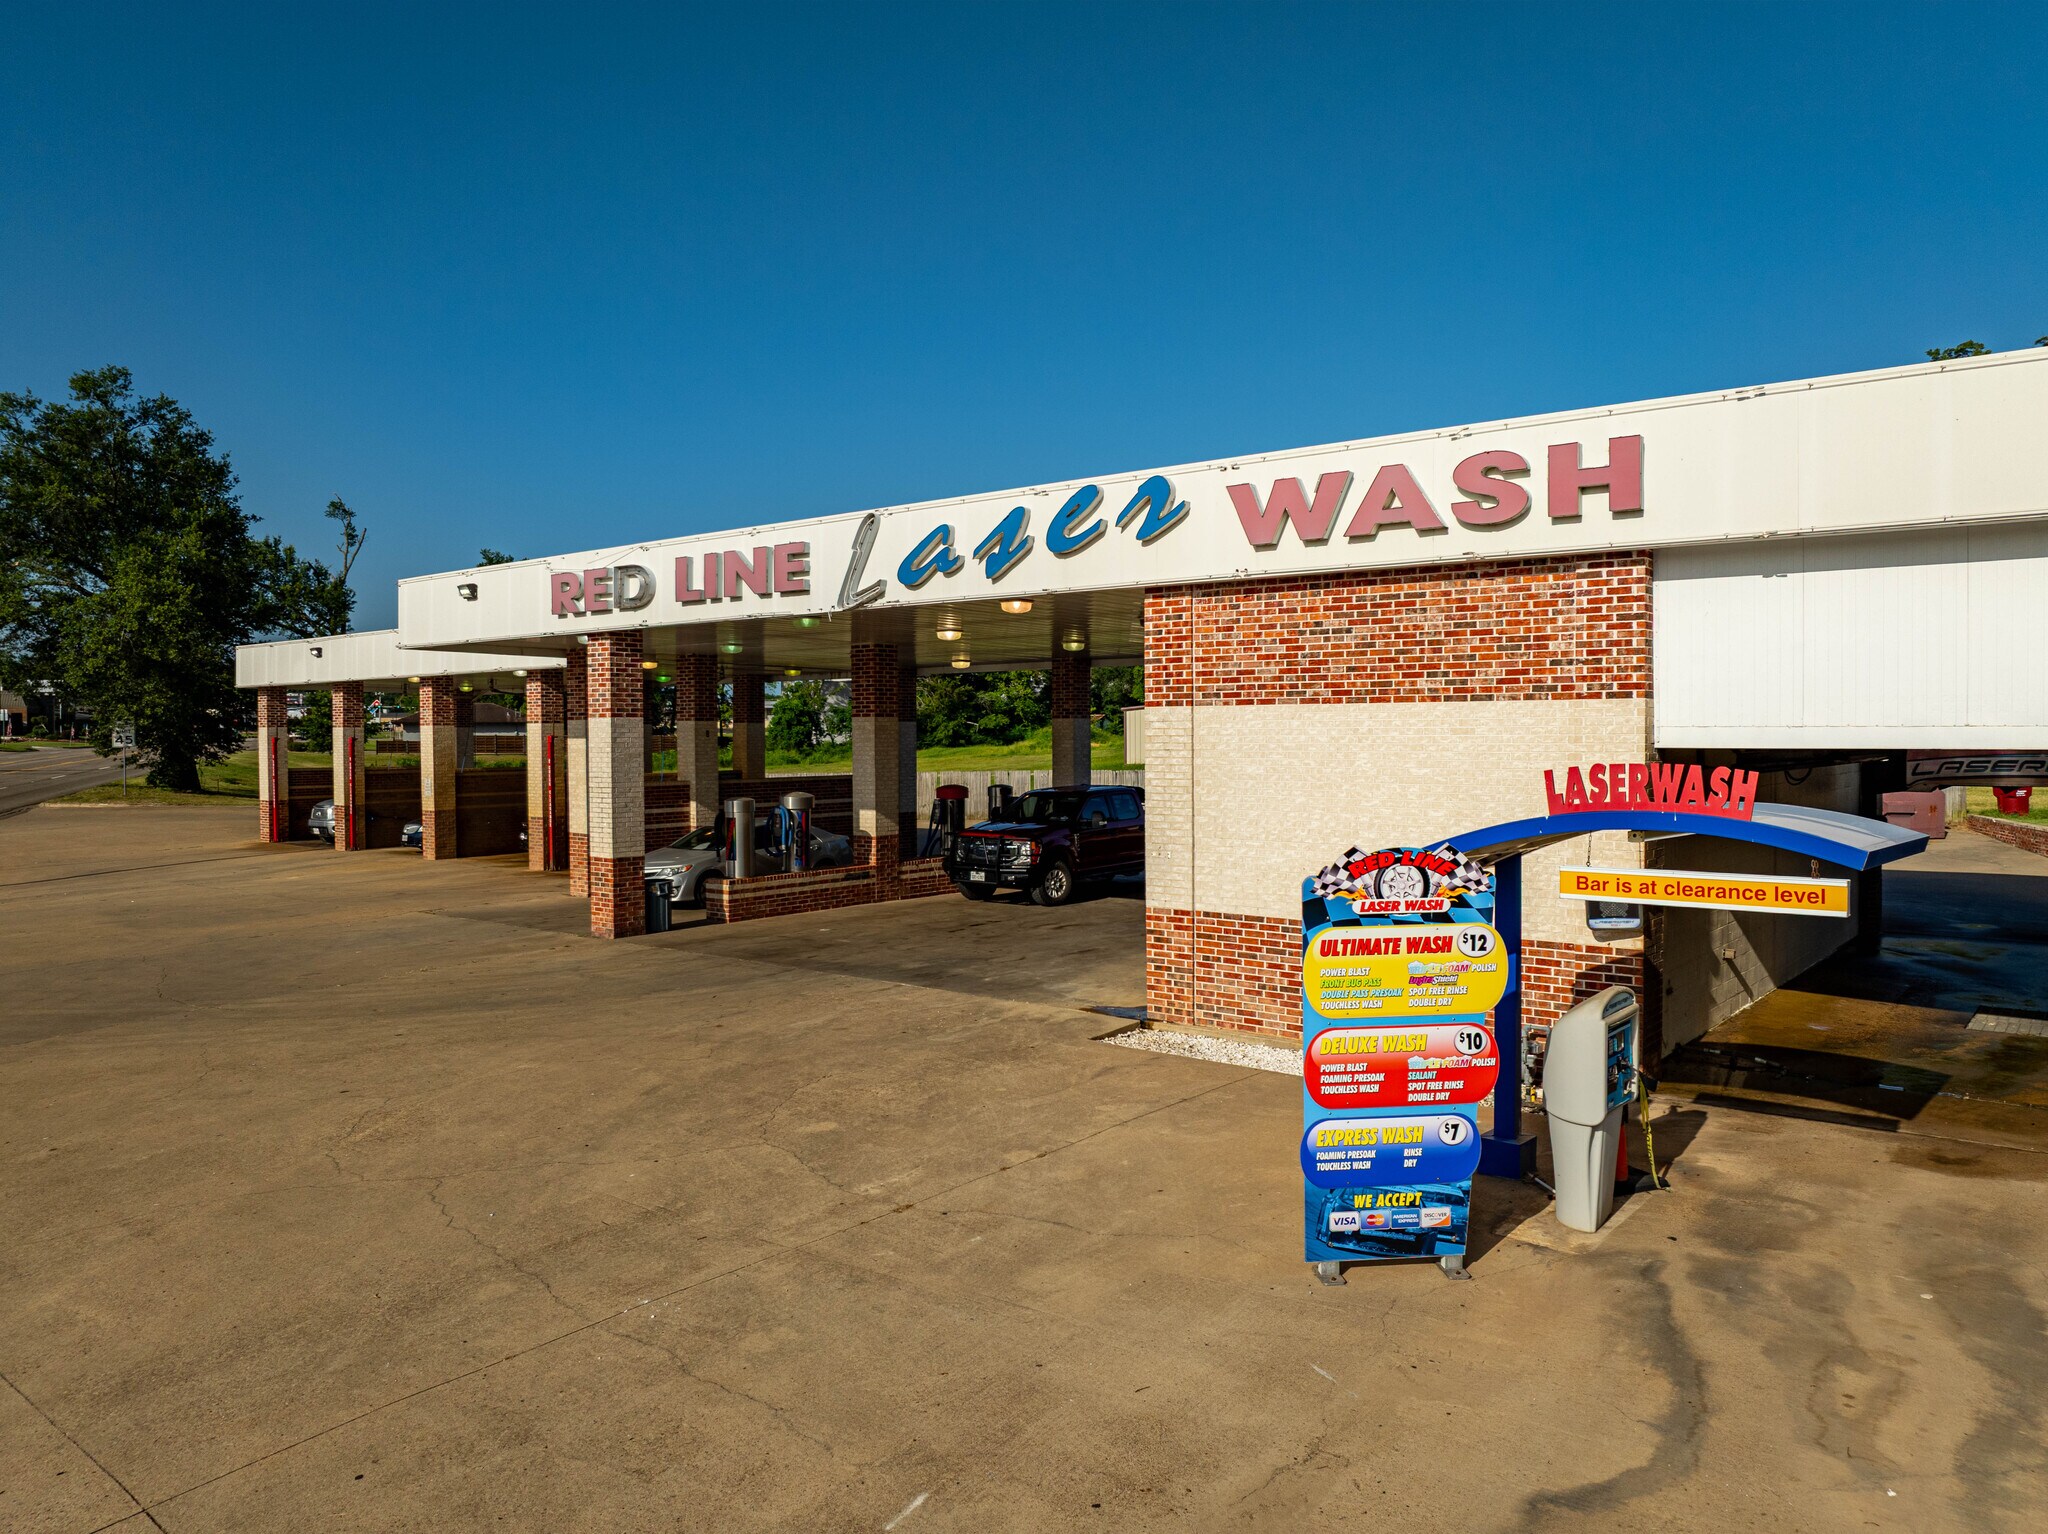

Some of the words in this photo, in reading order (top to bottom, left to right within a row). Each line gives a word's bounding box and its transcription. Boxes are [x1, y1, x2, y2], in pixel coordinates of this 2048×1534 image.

[551, 564, 656, 619] RED
[675, 541, 810, 606] LINE
[837, 475, 1191, 617] Laser
[1226, 435, 1645, 547] WASH
[114, 735, 133, 744] 45
[1544, 763, 1759, 818] LASERWASH
[1348, 852, 1395, 879] RED
[1400, 850, 1458, 876] LINE
[1576, 876, 1609, 892] Bar
[1616, 878, 1632, 893] is
[1639, 880, 1657, 895] at
[1664, 881, 1766, 901] clearance
[1774, 886, 1826, 904] level
[1360, 900, 1401, 912] LASER
[1405, 899, 1444, 911] WASH
[1320, 937, 1401, 957] ULTIMATE
[1406, 935, 1454, 954] WASH
[1462, 932, 1488, 952] $12
[1320, 968, 1346, 976] POWER
[1348, 968, 1370, 976] BLAST
[1472, 963, 1496, 972] POLISH
[1320, 980, 1344, 988] FRONT
[1346, 979, 1362, 987] BUG
[1363, 978, 1382, 986] PASS
[1320, 990, 1350, 999] DOUBLE
[1350, 990, 1369, 998] PASS
[1370, 988, 1404, 998] PRESOAK
[1408, 988, 1427, 996] SPOT
[1428, 987, 1445, 995] FREE
[1446, 986, 1468, 994] RINSE
[1321, 1000, 1360, 1010] TOUCHLESS
[1362, 1000, 1383, 1008] WASH
[1408, 998, 1436, 1006] DOUBLE
[1438, 998, 1453, 1006] DRY
[1320, 1036, 1379, 1055] DELUXE
[1382, 1034, 1428, 1053] WASH
[1460, 1032, 1483, 1050] $10
[1320, 1064, 1346, 1072] POWER
[1346, 1062, 1368, 1072] BLAST
[1472, 1058, 1496, 1066] POLISH
[1320, 1074, 1352, 1084] FOAMING
[1354, 1073, 1385, 1082] PRESOAK
[1408, 1071, 1437, 1080] SEALANT
[1321, 1085, 1358, 1094] TOUCHLESS
[1360, 1084, 1380, 1092] WASH
[1408, 1082, 1426, 1090] SPOT
[1427, 1082, 1442, 1090] FREE
[1444, 1080, 1464, 1089] RINSE
[1408, 1093, 1434, 1102] DOUBLE
[1436, 1092, 1450, 1100] DRY
[1316, 1128, 1378, 1147] EXPRESS
[1382, 1126, 1424, 1144] WASH
[1444, 1123, 1460, 1140] $7
[1316, 1152, 1346, 1160] FOAMING
[1347, 1150, 1376, 1159] PRESOAK
[1404, 1148, 1422, 1157] RINSE
[1316, 1162, 1351, 1171] TOUCHLESS
[1352, 1160, 1372, 1170] WASH
[1404, 1159, 1418, 1168] DRY
[1354, 1194, 1372, 1208] WE
[1376, 1192, 1422, 1207] ACCEPT
[1333, 1216, 1357, 1226] VISA
